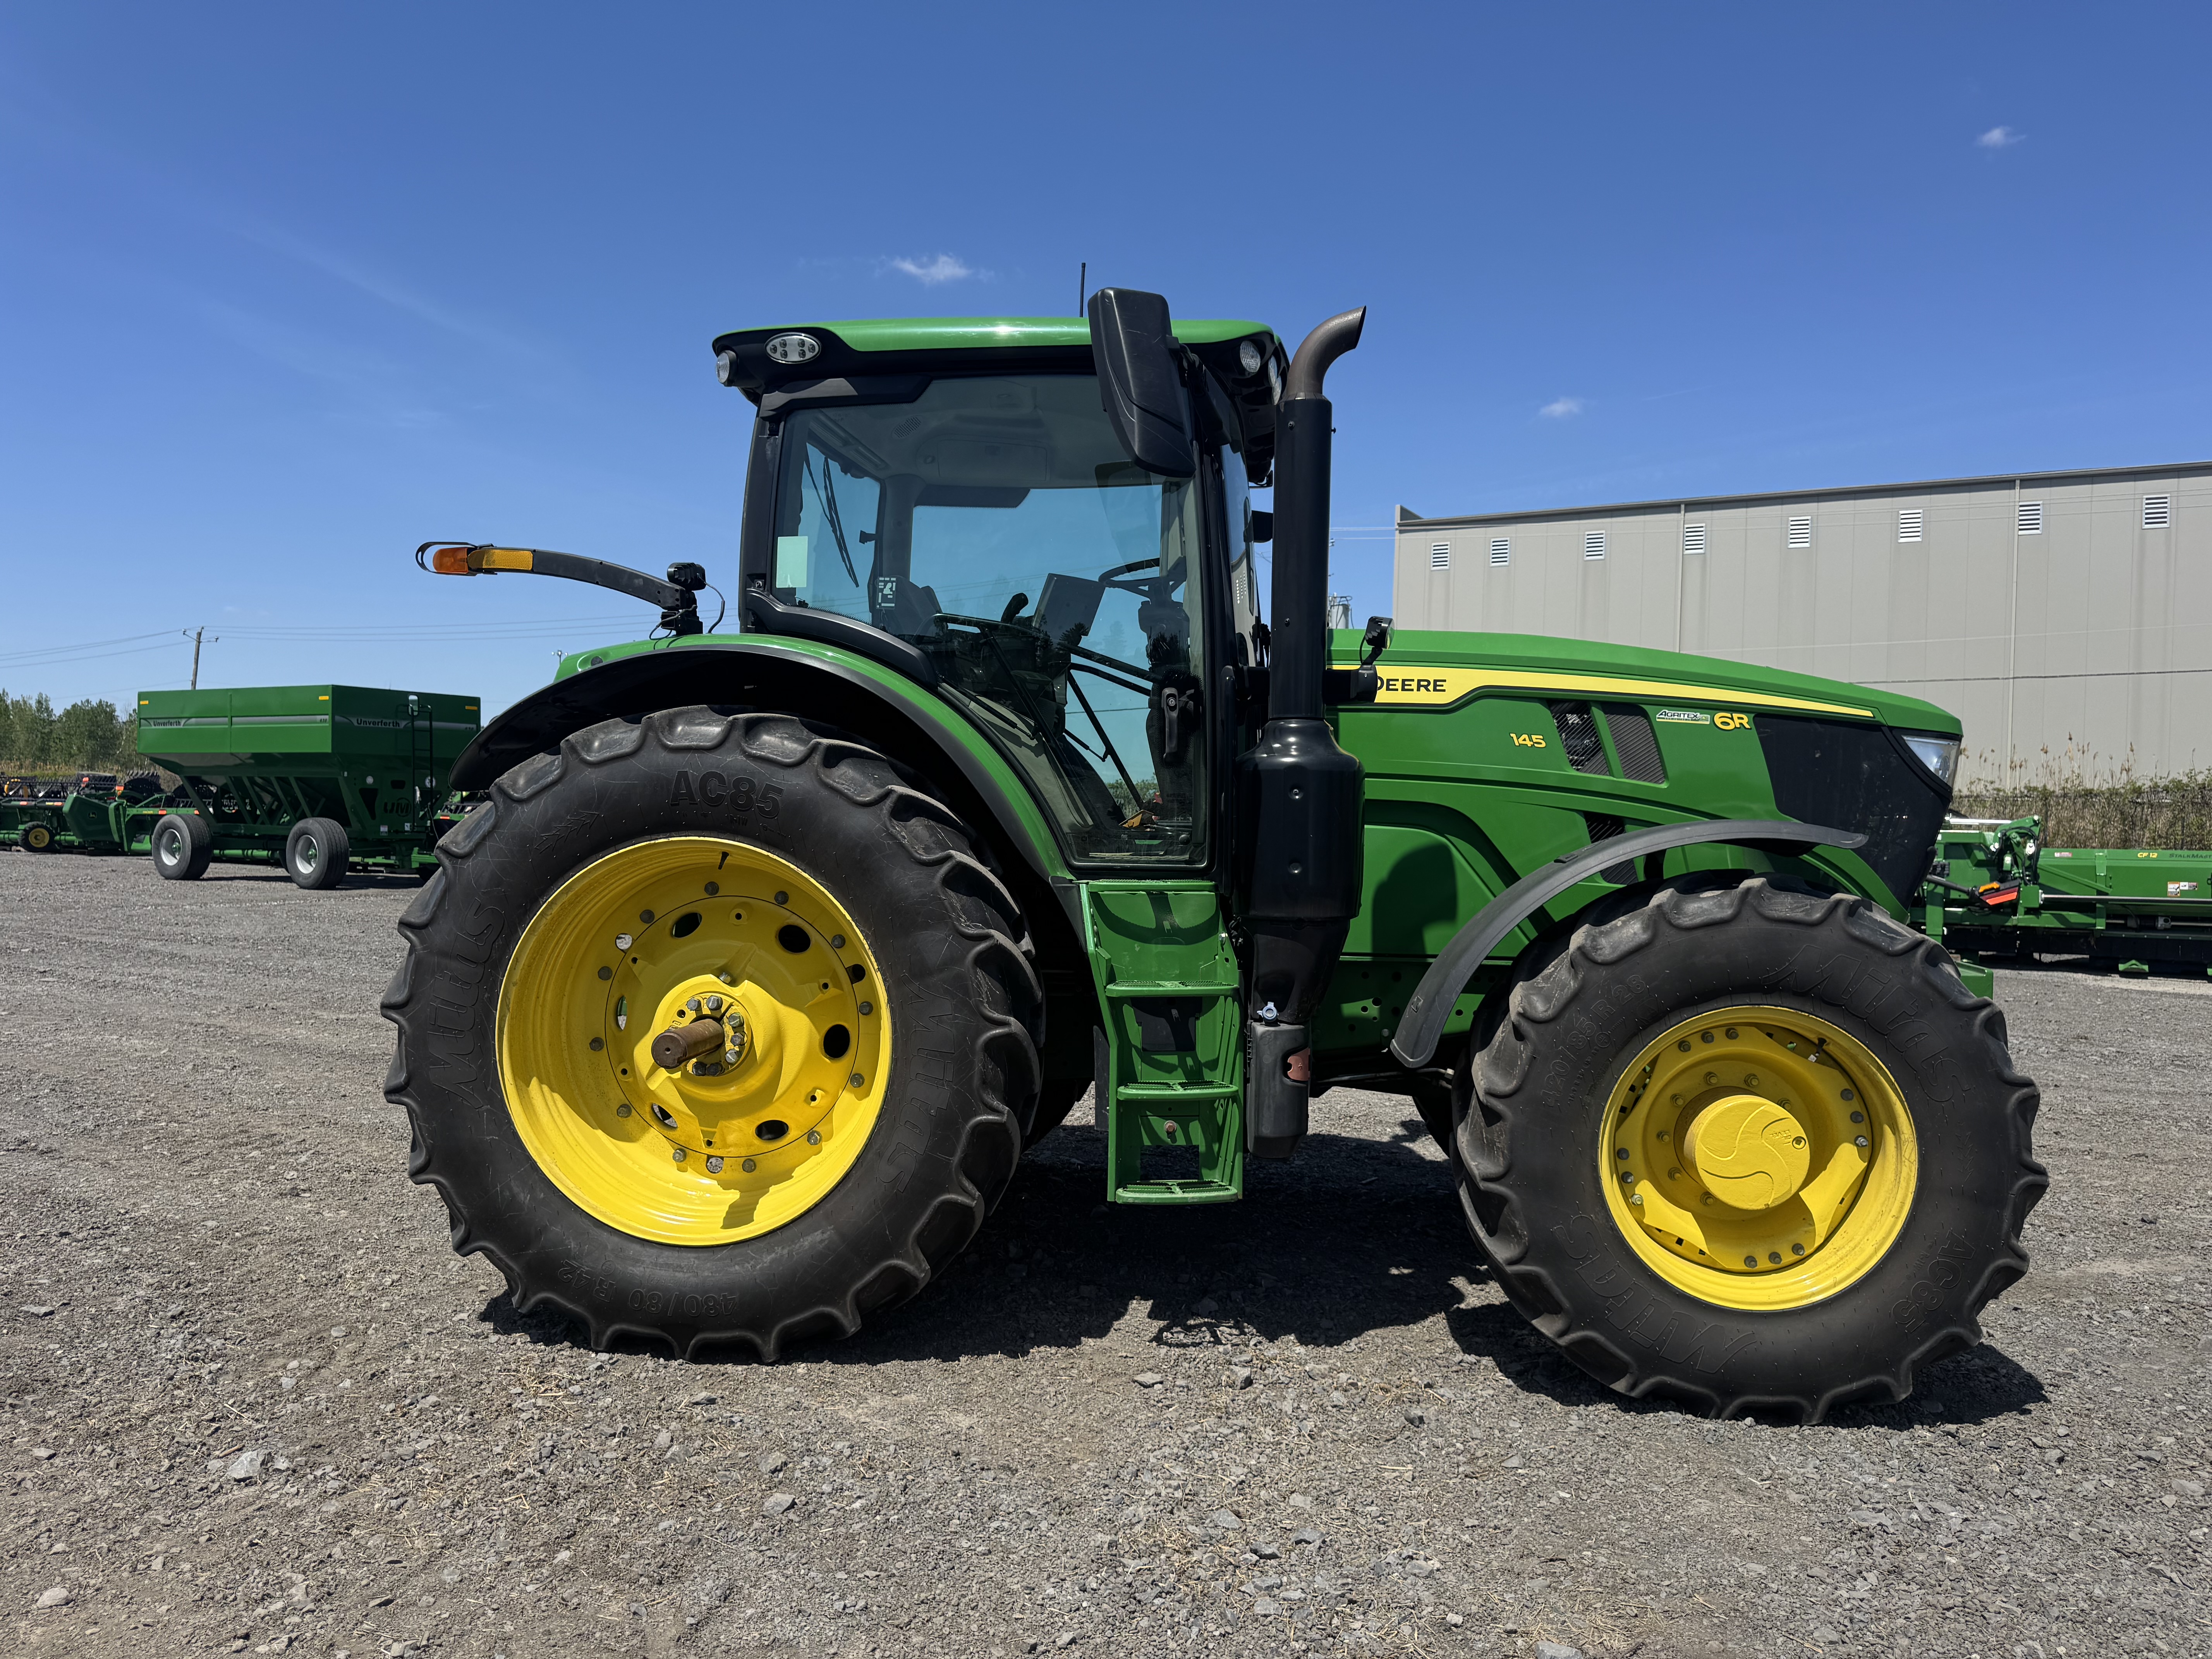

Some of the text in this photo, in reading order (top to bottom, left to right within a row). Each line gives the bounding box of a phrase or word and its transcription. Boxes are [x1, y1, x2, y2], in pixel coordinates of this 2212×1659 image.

[356, 718, 400, 728] Unverferth
[1658, 711, 1698, 719] AGRITEX
[1714, 712, 1751, 730] 6R
[1510, 733, 1546, 748] 145
[670, 769, 785, 818] AC85
[1891, 1229, 1976, 1333] AC85
